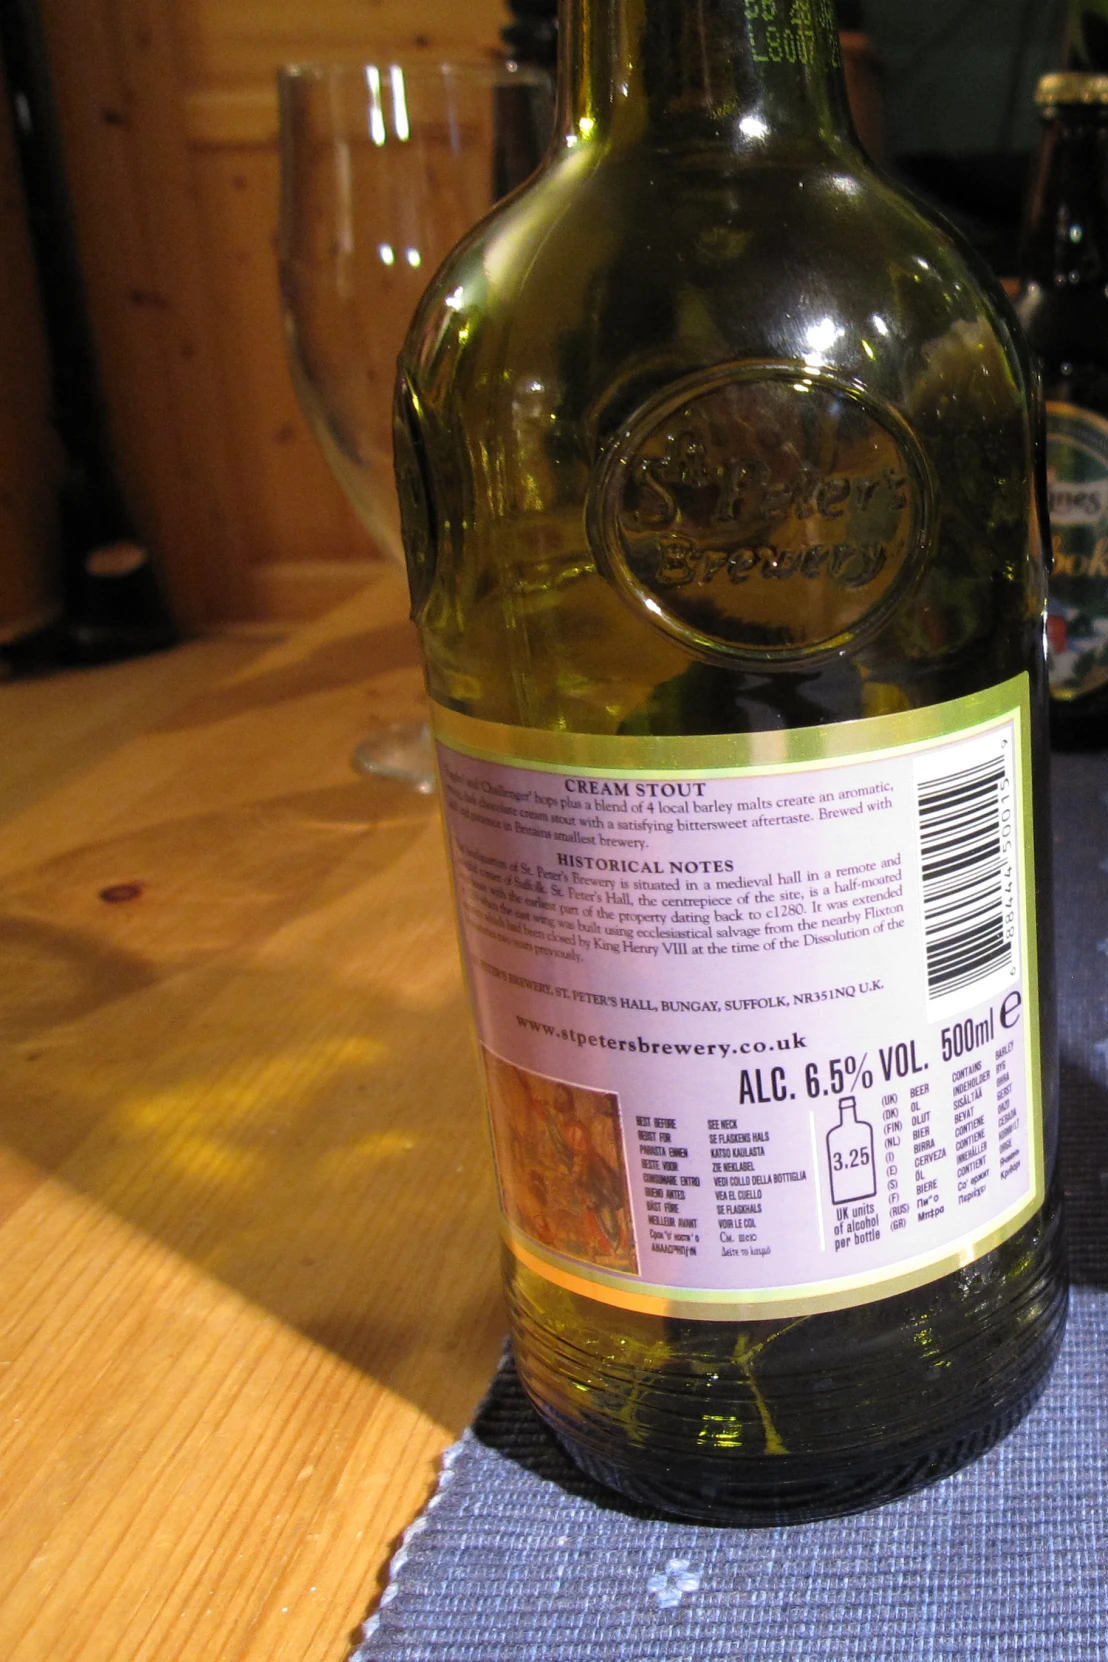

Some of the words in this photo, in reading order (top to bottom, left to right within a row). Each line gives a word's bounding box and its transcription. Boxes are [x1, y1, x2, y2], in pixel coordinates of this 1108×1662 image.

[1001, 739, 1008, 749] 9
[560, 796, 581, 810] plus
[595, 798, 626, 813] blend
[631, 801, 643, 813] of
[647, 801, 654, 814] 4
[658, 801, 689, 814] local
[694, 801, 732, 815] barley
[737, 797, 773, 811] malts
[776, 794, 815, 808] create
[819, 793, 834, 803] an
[839, 782, 894, 800] aromatic,
[565, 779, 629, 796] CREAM
[635, 782, 706, 798] STOUT
[520, 809, 548, 821] cream
[551, 814, 575, 825] stout
[580, 816, 604, 829] with
[617, 819, 674, 834] satisfying
[677, 819, 747, 831] bittersweet
[752, 814, 814, 827] aftertaste.
[819, 801, 863, 820] Brewed
[867, 797, 893, 811] with
[1000, 777, 1012, 853] 50015
[554, 830, 595, 845] smallest
[599, 834, 649, 850] brewery.
[557, 853, 664, 874] HISTORICAL
[670, 860, 734, 873] NOTES
[572, 872, 615, 889] Brewery
[633, 879, 680, 891] situated
[686, 879, 698, 890] in
[704, 882, 710, 890] a
[716, 874, 772, 890] medieval
[778, 871, 801, 885] hall
[807, 871, 819, 881] in
[824, 871, 831, 879] a
[836, 863, 876, 877] remote
[881, 853, 901, 868] and
[568, 889, 602, 903] Peter's
[606, 892, 633, 906] Hall,
[638, 894, 657, 906] the
[661, 894, 732, 909] centrepiece
[737, 893, 750, 904] of
[755, 892, 774, 903] the
[780, 890, 805, 902] site,
[810, 887, 818, 897] is
[823, 887, 830, 895] a
[834, 869, 902, 894] half-moated
[560, 903, 579, 916] part
[582, 906, 594, 916] of
[597, 909, 614, 920] the
[618, 910, 665, 925] property
[671, 911, 710, 925] dating
[715, 909, 744, 922] back
[749, 910, 762, 920] to
[766, 903, 807, 919] c1280.
[827, 900, 848, 911] was
[852, 885, 903, 905] extended
[1004, 866, 1015, 939] 88444
[558, 919, 574, 930] was
[577, 920, 600, 933] built
[605, 925, 634, 939] using
[636, 927, 713, 939] ecclesiastical
[716, 926, 761, 940] salvage
[765, 921, 794, 934] from
[798, 918, 818, 930] the
[822, 911, 861, 928] nearby
[865, 903, 904, 920] Flixton
[579, 935, 590, 950] by
[594, 938, 620, 954] King
[623, 941, 659, 956] Henry
[662, 943, 687, 955] VIII
[692, 945, 703, 955] at
[708, 943, 727, 954] the
[732, 941, 760, 953] time
[764, 938, 776, 951] of
[780, 935, 800, 949] the
[804, 926, 870, 946] Dissolution
[873, 920, 885, 933] of
[888, 918, 905, 931] the
[1009, 966, 1016, 976] 6
[555, 987, 570, 999] ST.
[573, 991, 617, 1007] PETER'S
[620, 997, 658, 1012] HALL,
[660, 1000, 722, 1013] BUNGAY,
[725, 996, 789, 1011] SUFFOLK,
[793, 985, 856, 1005] NR351NQ
[859, 979, 884, 994] U.K.
[516, 1015, 807, 1058] www.stpetersbrewery.co.uk
[739, 1066, 796, 1104] ALC.
[805, 1052, 873, 1099] 6.5%
[879, 1040, 929, 1081] VOL.
[941, 1007, 994, 1062] 500ml
[882, 1093, 897, 1107] (UK)
[910, 1083, 929, 1098] BEER
[952, 1063, 982, 1082] CONTAINS
[708, 1120, 719, 1130] SEE
[721, 1119, 737, 1129] NECK
[883, 1107, 898, 1121] (DK)
[884, 1121, 902, 1135] (FIN)
[912, 1111, 930, 1126] OLUT
[709, 1134, 718, 1144] SE
[719, 1132, 751, 1144] FLASKENS
[752, 1132, 769, 1142] HALS
[885, 1136, 900, 1149] (NL)
[913, 1126, 929, 1140] BIER
[955, 1107, 974, 1124] BEVAT
[914, 1139, 935, 1154] BIRRA
[955, 1115, 984, 1137] CONTIENE
[711, 1148, 731, 1158] KATSO
[732, 1147, 765, 1158] KAULASTA
[833, 1146, 869, 1171] 3.25
[887, 1165, 897, 1177] (E)
[915, 1148, 946, 1167] CERVEZA
[956, 1129, 985, 1151] CONTIENE
[723, 1162, 755, 1172] NEKLABEL
[714, 1176, 728, 1187] VEDI
[730, 1175, 750, 1186] COLLO
[752, 1174, 772, 1185] DELLA
[773, 1171, 806, 1184] BOTTIGLIA
[888, 1179, 897, 1191] (S)
[889, 1193, 899, 1204] (F)
[917, 1179, 937, 1195] BIERE
[957, 1155, 986, 1178] CONTIENT
[716, 1191, 727, 1200] VEA
[729, 1190, 736, 1200] EL
[738, 1190, 762, 1200] CUELLO
[717, 1205, 725, 1214] SE
[726, 1204, 762, 1214] FLASKHALS
[836, 1207, 849, 1221] UK
[852, 1203, 875, 1217] units
[889, 1203, 909, 1218] (RUS)
[718, 1219, 733, 1228] VOIR
[735, 1218, 742, 1228] LE
[744, 1218, 756, 1228] COL
[834, 1223, 844, 1235] of
[847, 1214, 879, 1229] alcohol
[890, 1218, 906, 1232] (GR)
[835, 1237, 851, 1252] per
[854, 1229, 881, 1245] bottle
